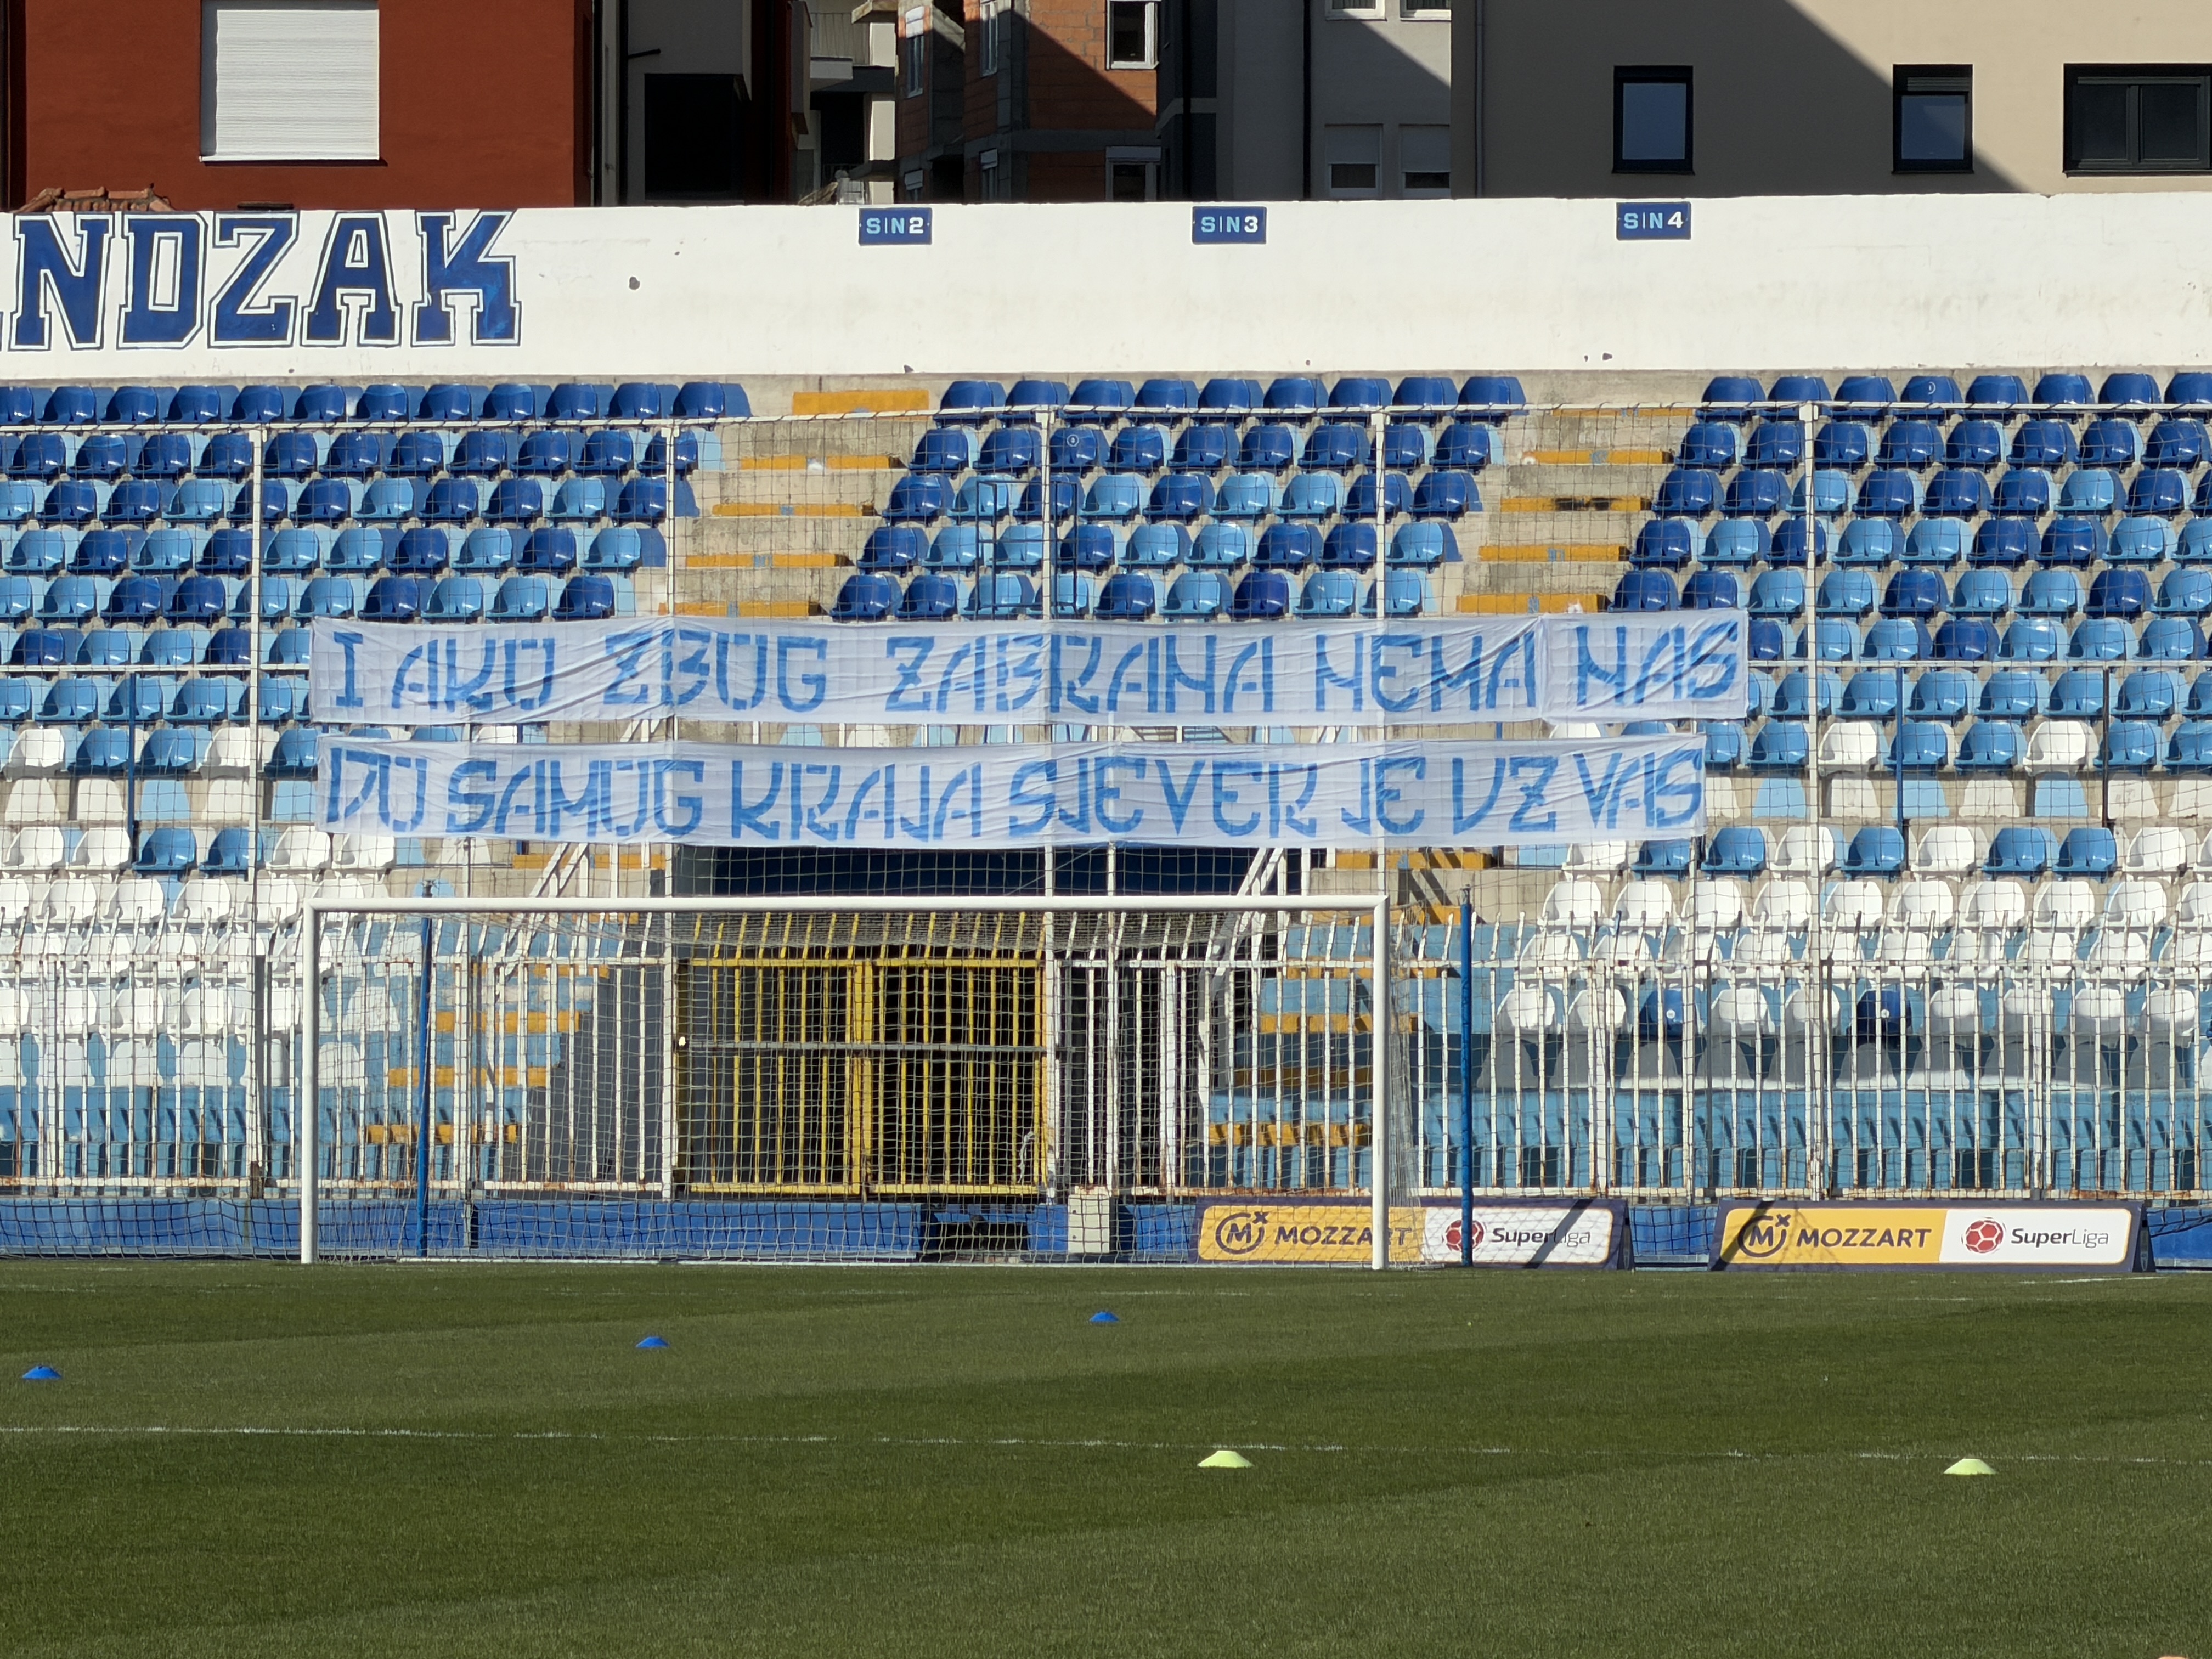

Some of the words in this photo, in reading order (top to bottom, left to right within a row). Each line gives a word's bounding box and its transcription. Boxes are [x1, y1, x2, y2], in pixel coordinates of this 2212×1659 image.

[866, 217, 905, 234] SIN
[909, 217, 924, 234] 2
[1201, 216, 1240, 233] SIN
[1244, 215, 1259, 233] 3
[1624, 212, 1663, 229] SIN
[1668, 212, 1683, 228] 4
[0, 210, 522, 351] NDZAK
[334, 632, 363, 707] I
[392, 637, 555, 712] AKO
[1316, 632, 1537, 713] NEMA
[1576, 620, 1739, 706] NAS
[445, 758, 704, 837] SAMOG
[731, 760, 981, 842] KRAJA
[1008, 757, 1317, 839] SJEVER
[1341, 756, 1426, 834] JE
[1572, 749, 1703, 830] VAS
[1274, 1226, 1412, 1246] MOZZAT
[1796, 1228, 1932, 1249] MOZZART
[2011, 1228, 2109, 1249] SuperLiga
